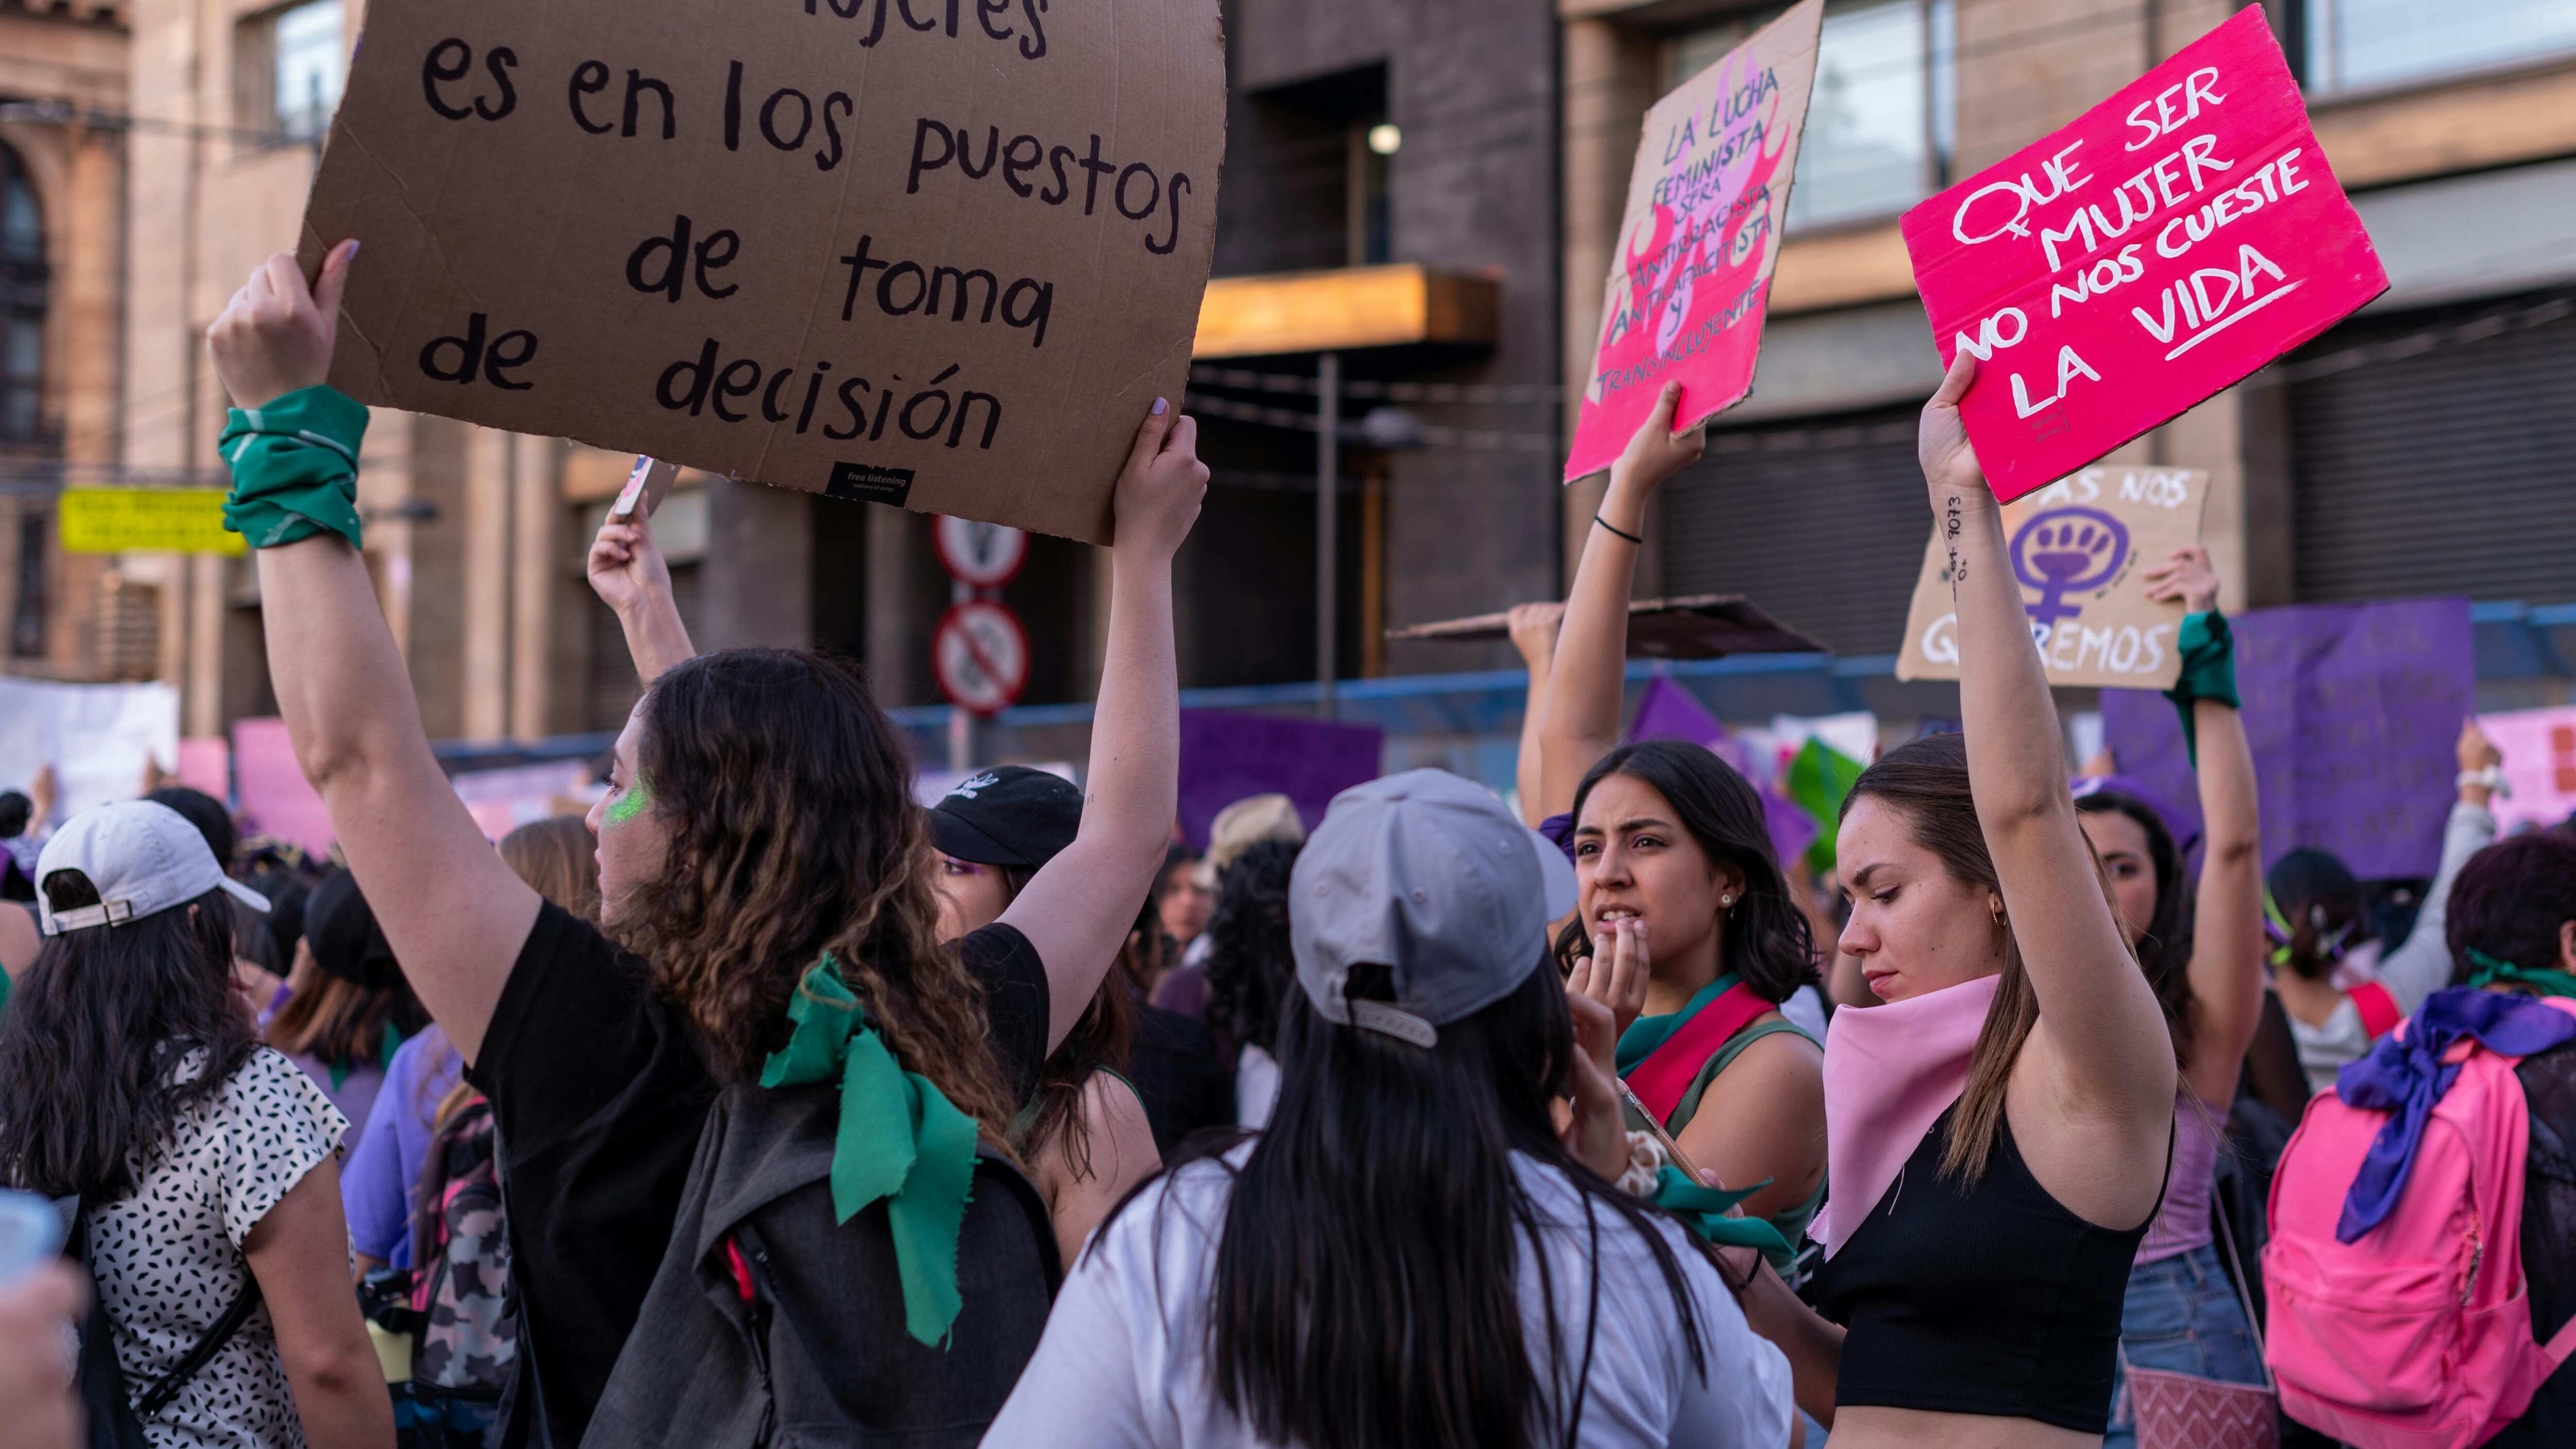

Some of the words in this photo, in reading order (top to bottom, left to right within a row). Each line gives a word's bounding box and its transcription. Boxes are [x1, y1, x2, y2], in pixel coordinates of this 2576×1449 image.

[423, 38, 518, 121] es
[569, 60, 675, 139] en
[725, 60, 853, 171] los
[907, 118, 1191, 255] puestos
[1650, 120, 1764, 216] FEMINISTA
[1663, 117, 1695, 166] LA
[1709, 67, 1778, 138] LUCHA
[1953, 139, 2094, 245] QUE
[2125, 66, 2227, 152] SER
[1627, 181, 1771, 300] ANTIRRACISTA
[1956, 308, 2027, 361] NO
[2052, 244, 2144, 319] NOS
[2157, 148, 2309, 258] CUESTE
[2041, 134, 2235, 273] MUJER
[626, 215, 740, 303] de
[841, 234, 1053, 348] toma
[1597, 279, 1760, 402] TRANSINCLUYENTE
[1608, 210, 1772, 345] ANTICAPACITISTA
[2010, 345, 2101, 418] LA
[2131, 244, 2286, 343] VIDA
[419, 313, 537, 389] de
[656, 338, 1001, 449] decisión
[848, 472, 866, 481] free
[868, 474, 906, 487] listening
[1947, 496, 1960, 540] 9073
[2118, 470, 2192, 509] NOS
[1921, 613, 2173, 673] QREMOS
